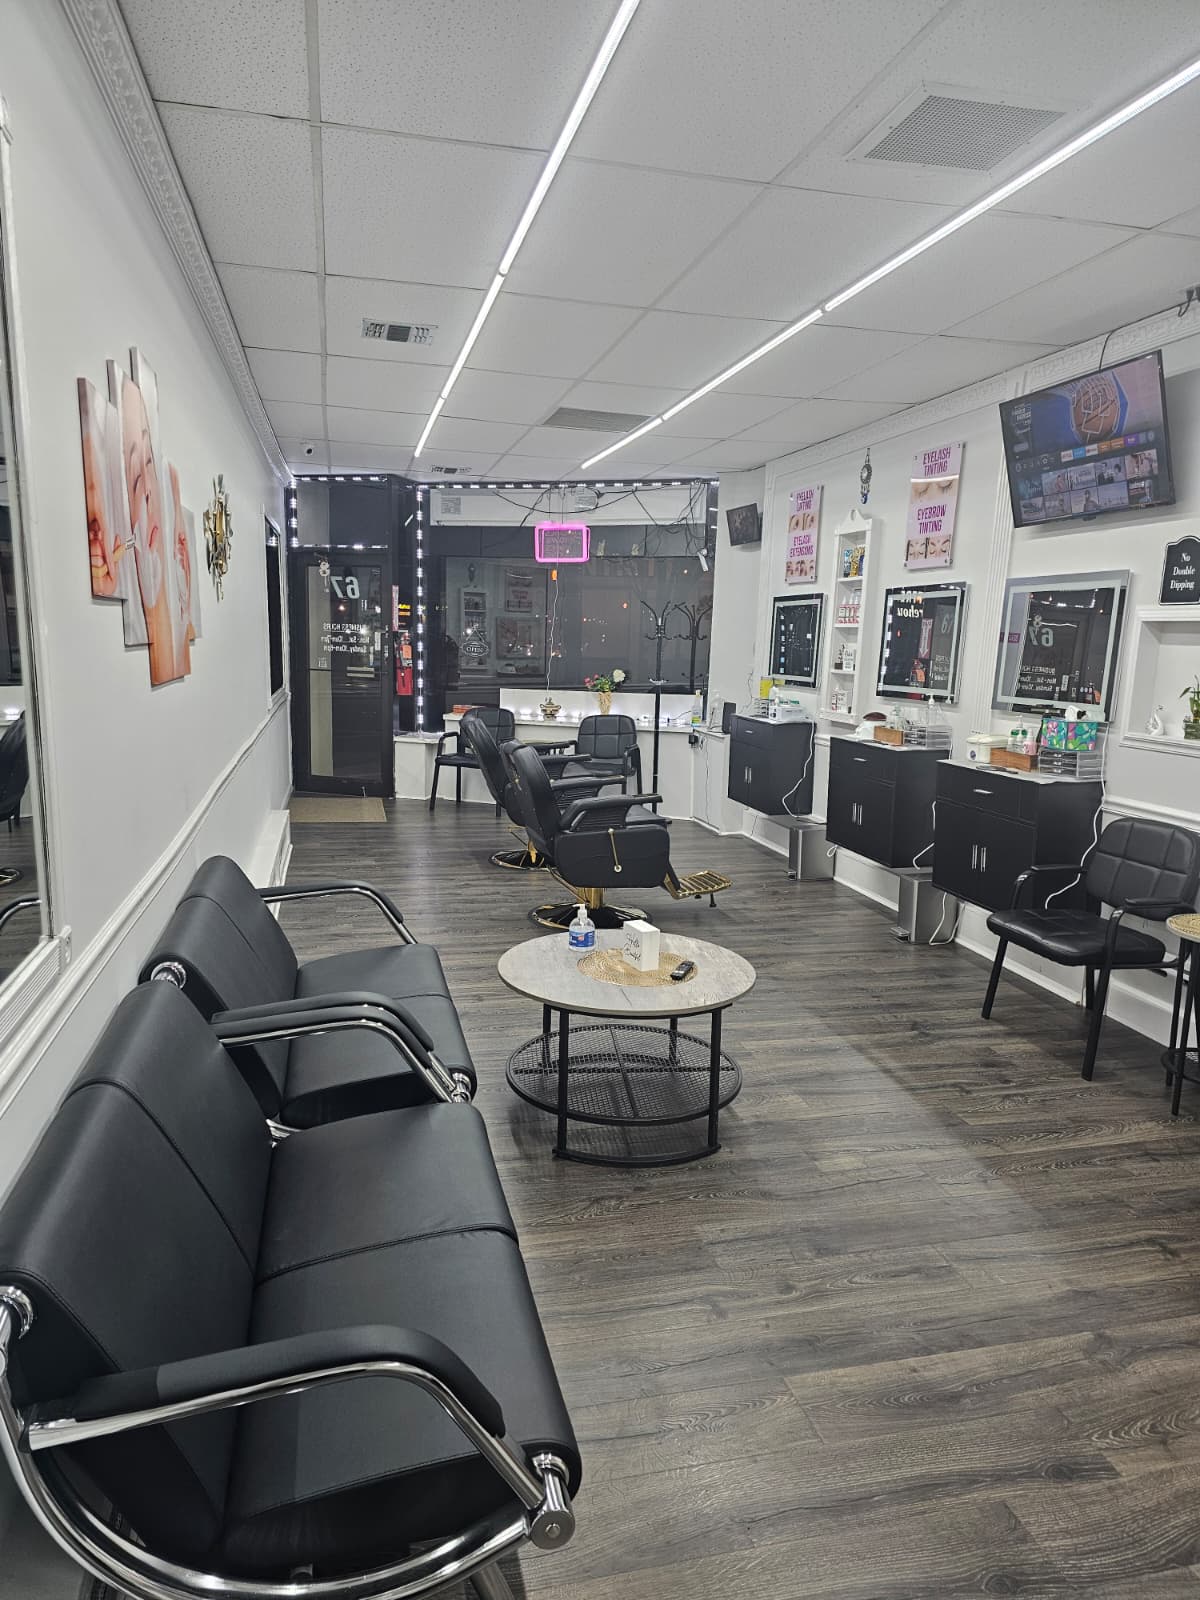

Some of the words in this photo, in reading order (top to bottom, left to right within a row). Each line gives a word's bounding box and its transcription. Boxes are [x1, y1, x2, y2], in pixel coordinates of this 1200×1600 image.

[922, 447, 951, 465] EYELASH
[924, 461, 948, 477] TINTING
[796, 489, 814, 501] EYELASH
[917, 504, 946, 521] EYEBROW
[919, 520, 942, 534] TINTING
[793, 535, 811, 546] EYELASH
[790, 545, 813, 557] EXTENSIONS
[1181, 553, 1190, 562] No
[1173, 566, 1195, 575] Double
[1170, 580, 1195, 591] Dipping
